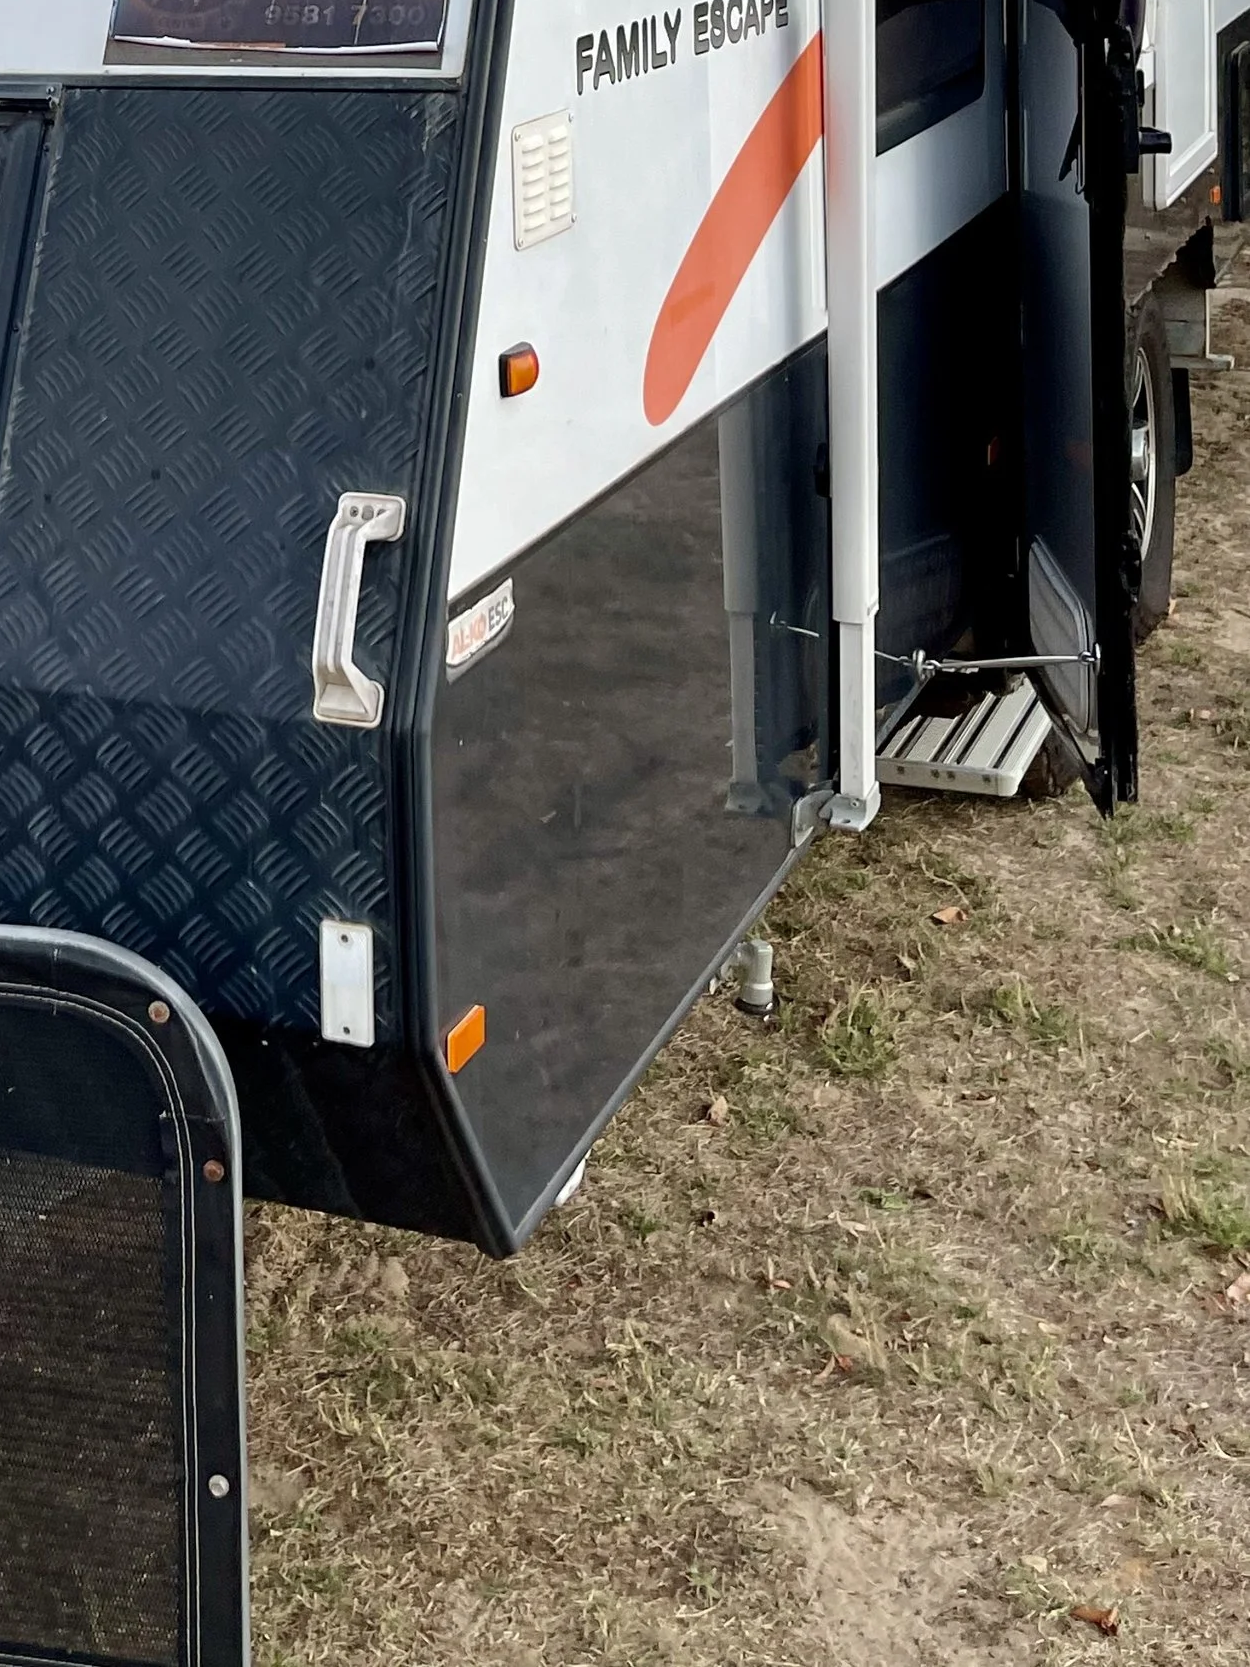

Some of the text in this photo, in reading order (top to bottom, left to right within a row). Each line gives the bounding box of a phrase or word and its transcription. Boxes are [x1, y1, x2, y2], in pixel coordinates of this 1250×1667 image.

[264, 5, 335, 26] 9581
[575, 7, 682, 96] FAMILY
[487, 594, 510, 633] ESC
